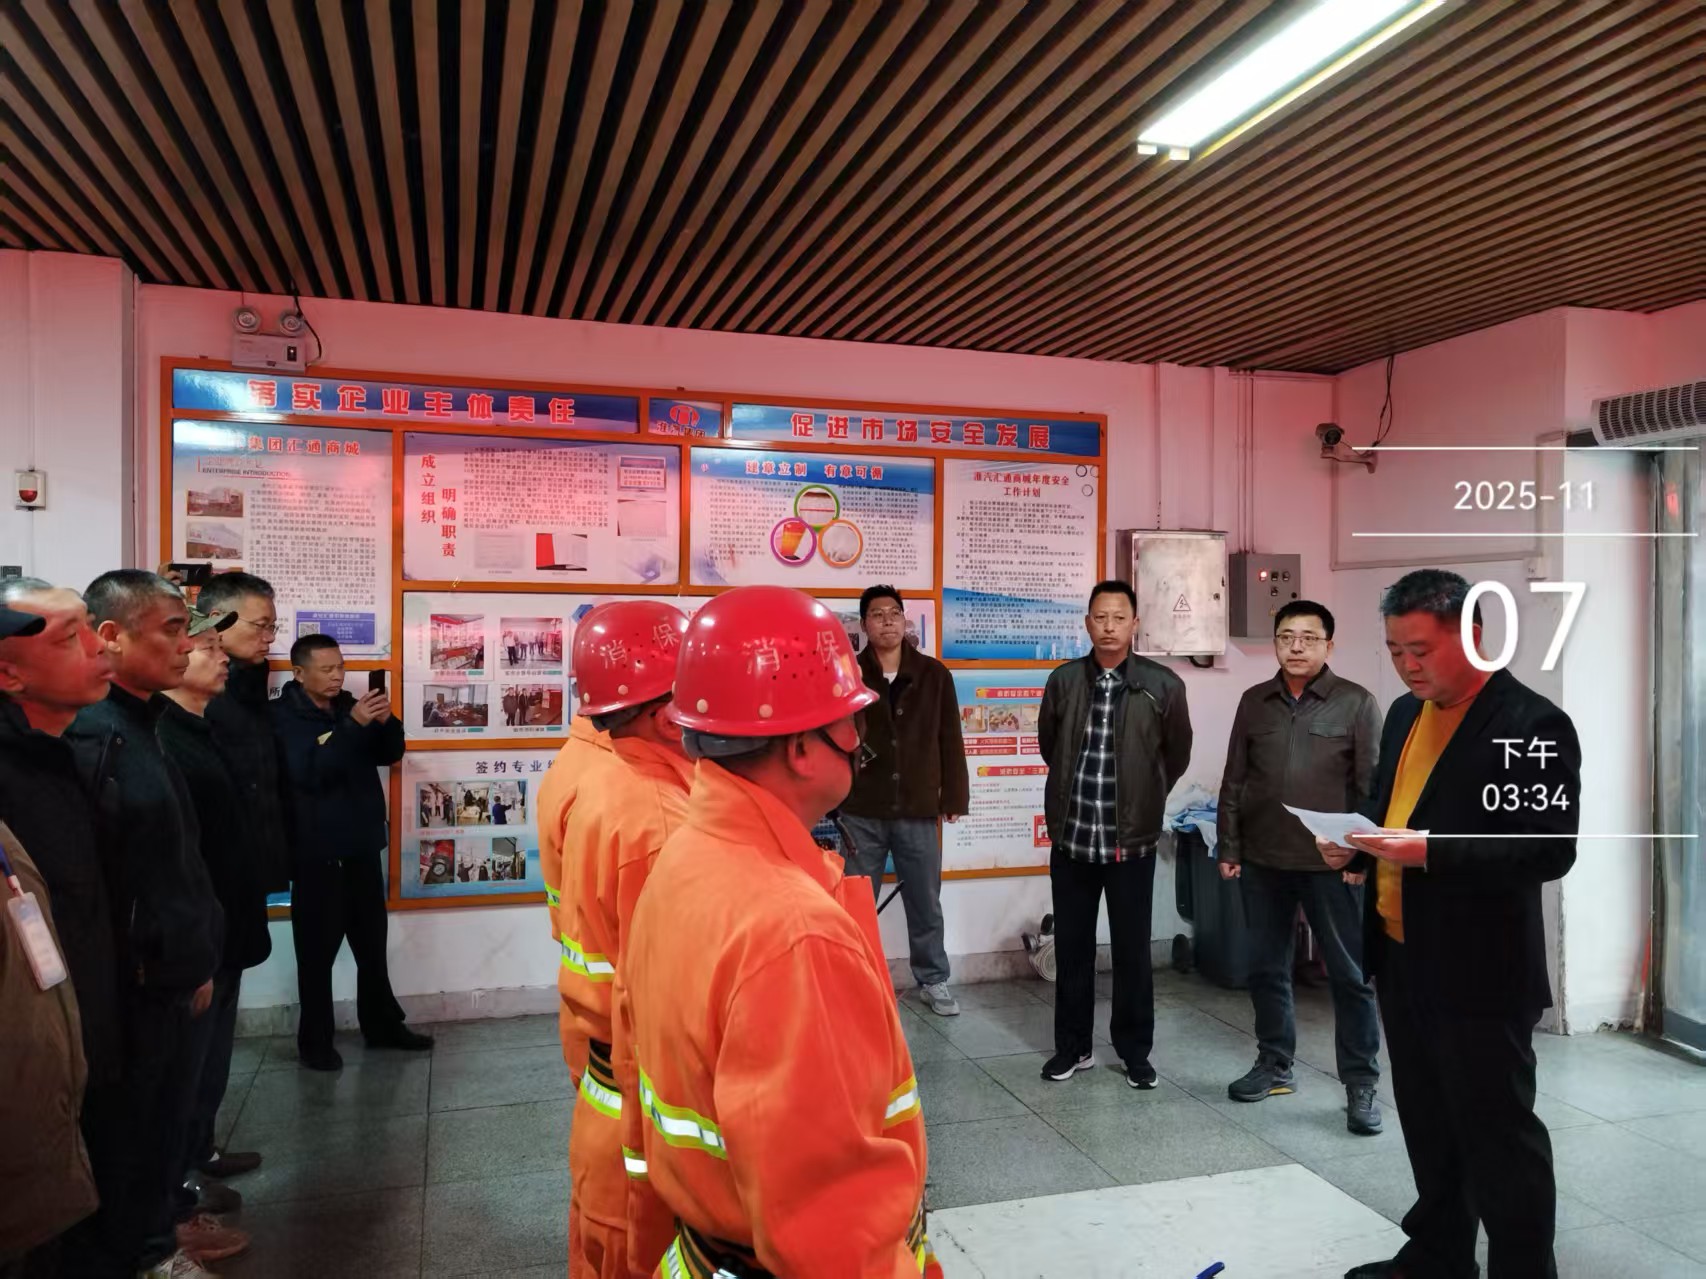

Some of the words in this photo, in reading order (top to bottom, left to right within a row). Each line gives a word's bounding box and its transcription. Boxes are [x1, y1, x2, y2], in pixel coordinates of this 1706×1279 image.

[247, 379, 576, 425] 落实企业主体责任
[790, 412, 1051, 450] 促进市场安全发展
[202, 467, 241, 475] ENTERPRISE
[746, 460, 808, 476] 建章立制
[824, 464, 884, 481] 有章可循
[973, 471, 1070, 486] 淮汽汇通商城年度安全
[420, 454, 436, 524] 成立组织
[1003, 487, 1041, 498] 工作计划
[441, 488, 457, 558] 明确职责
